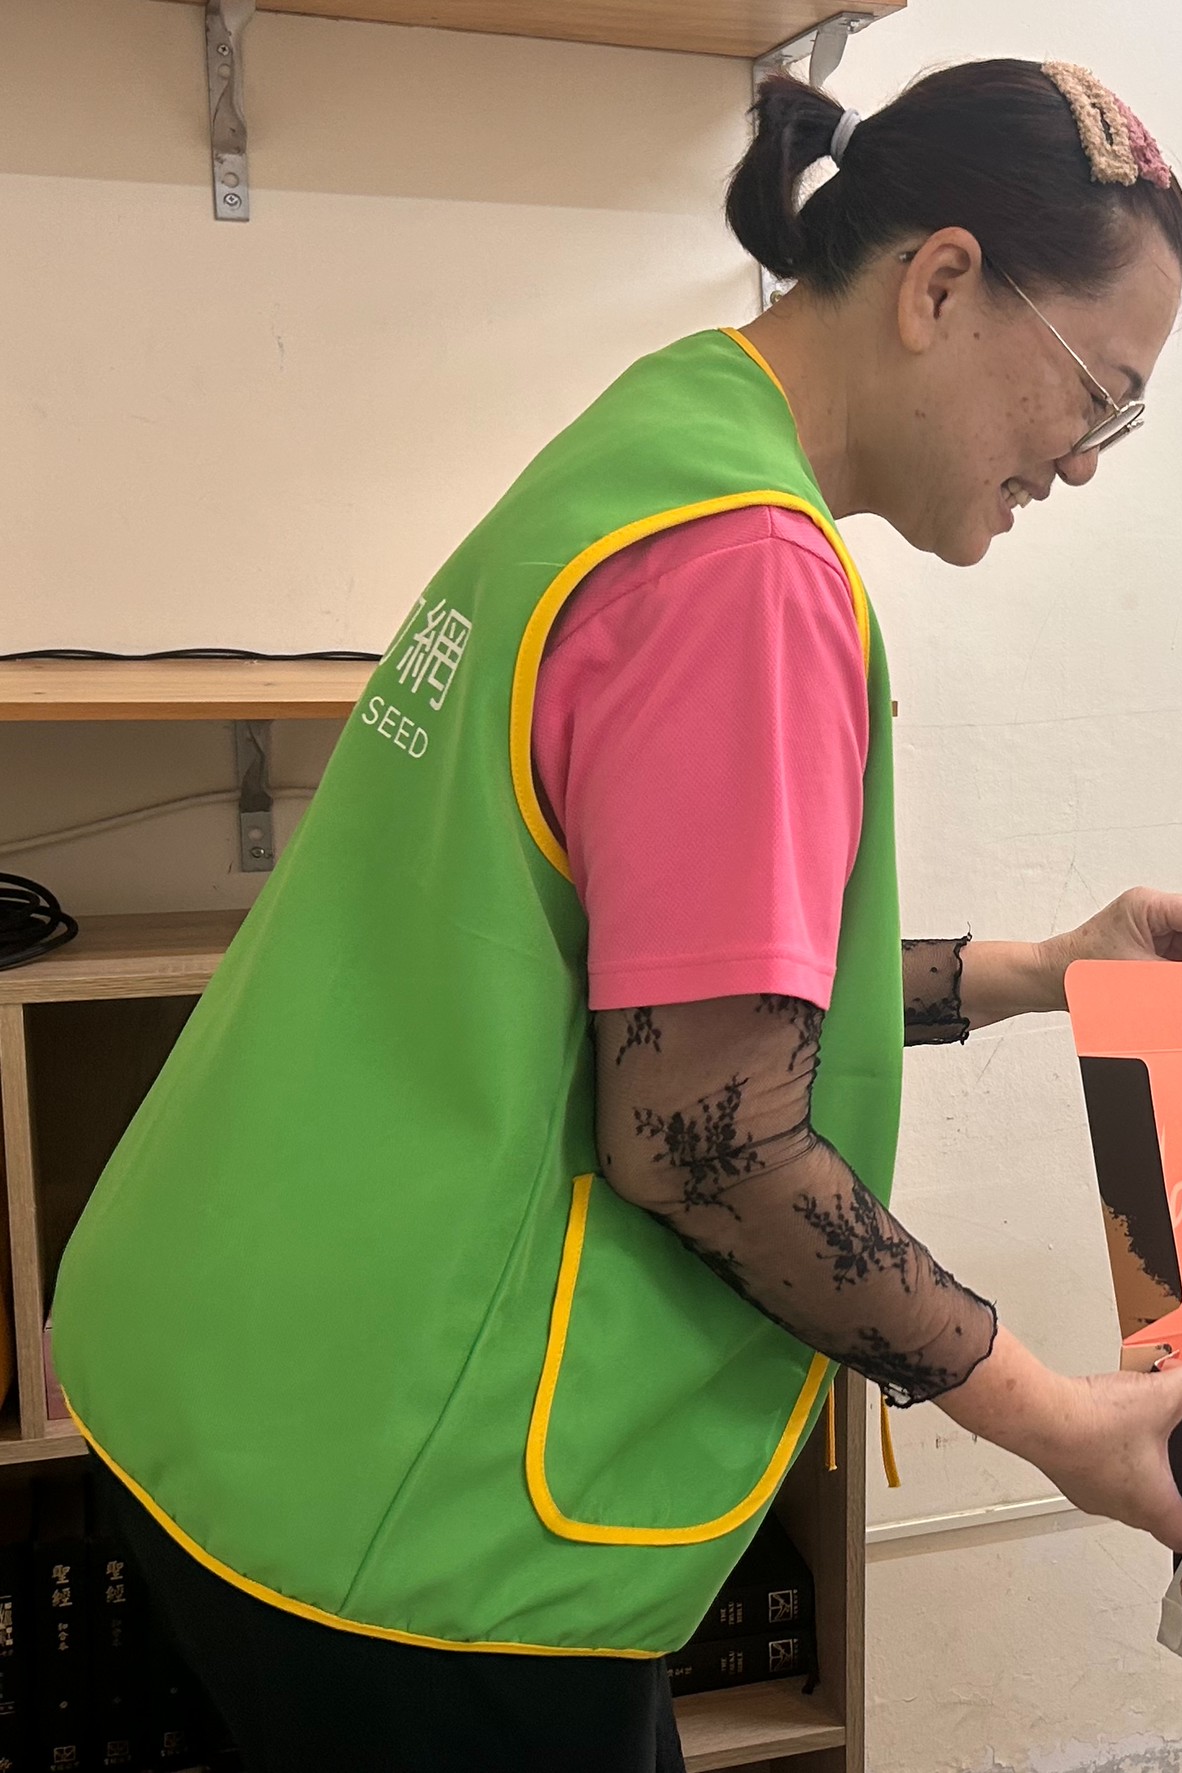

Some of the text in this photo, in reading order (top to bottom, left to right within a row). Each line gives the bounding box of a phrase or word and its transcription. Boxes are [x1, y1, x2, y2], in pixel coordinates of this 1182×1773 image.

[379, 596, 472, 711] 網
[362, 696, 429, 758] SEED
[51, 1564, 73, 1607] 聖經
[105, 1560, 127, 1603] 聖經
